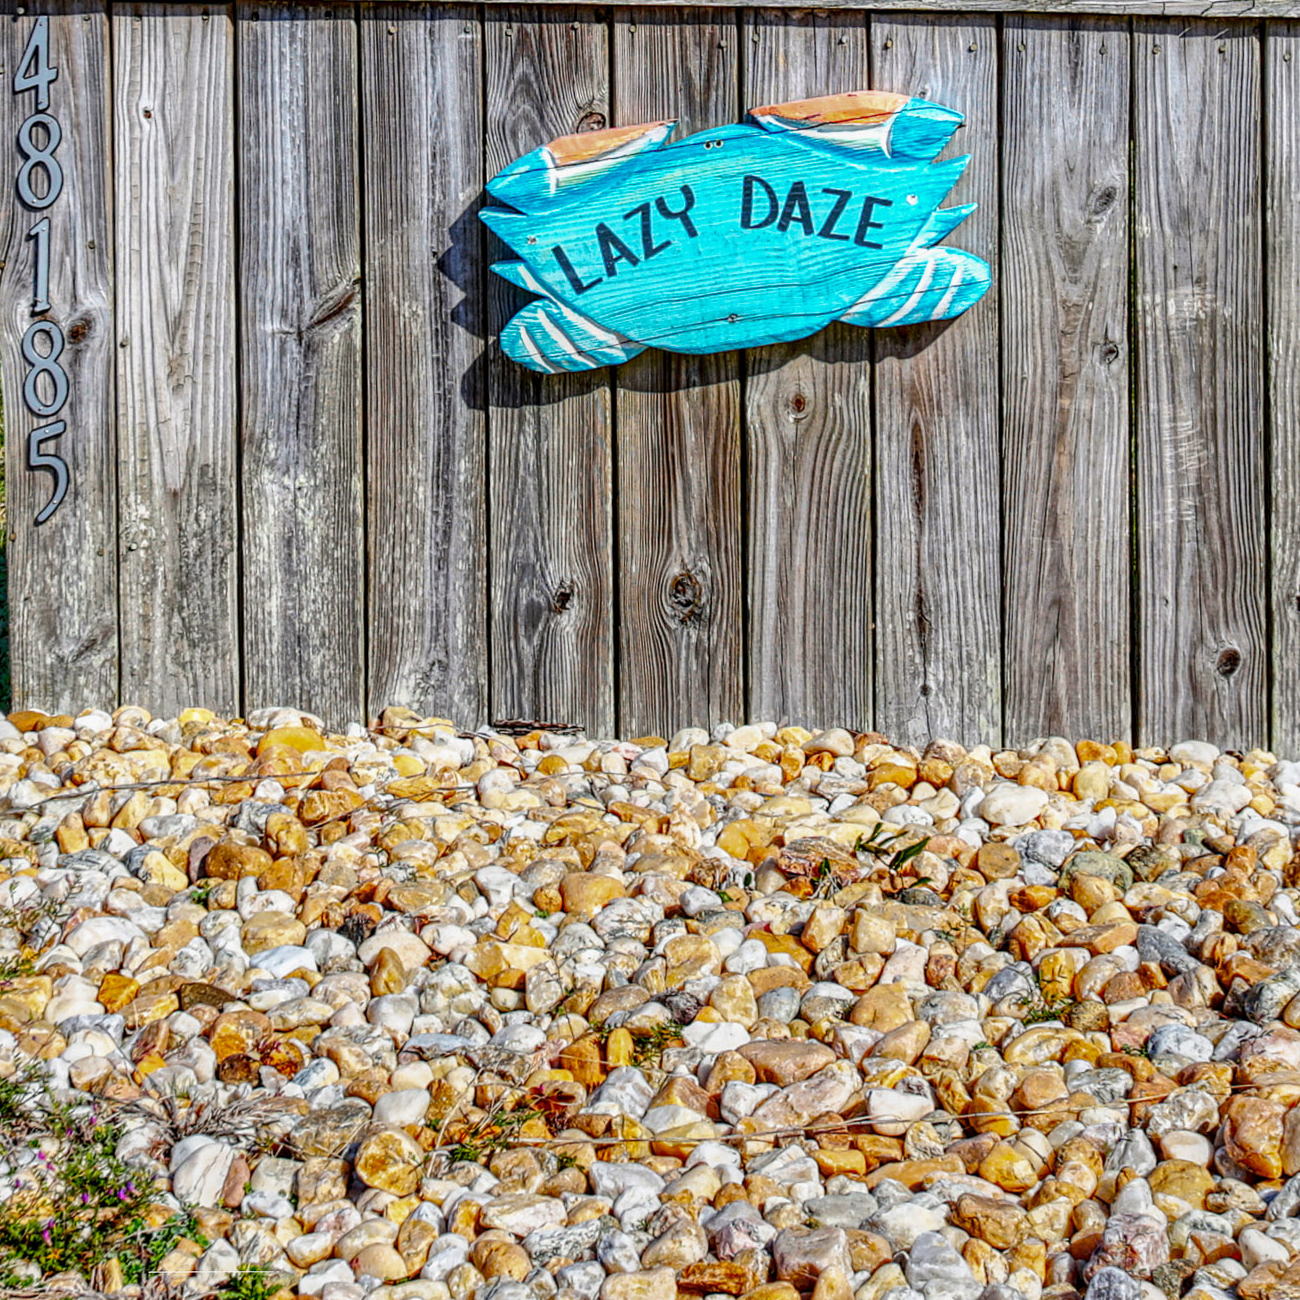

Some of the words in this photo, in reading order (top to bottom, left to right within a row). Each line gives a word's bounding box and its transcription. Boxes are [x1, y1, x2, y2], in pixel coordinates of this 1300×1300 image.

[13, 15, 70, 523] 48185
[551, 185, 699, 296] LAZY
[741, 174, 893, 250] DAZE
